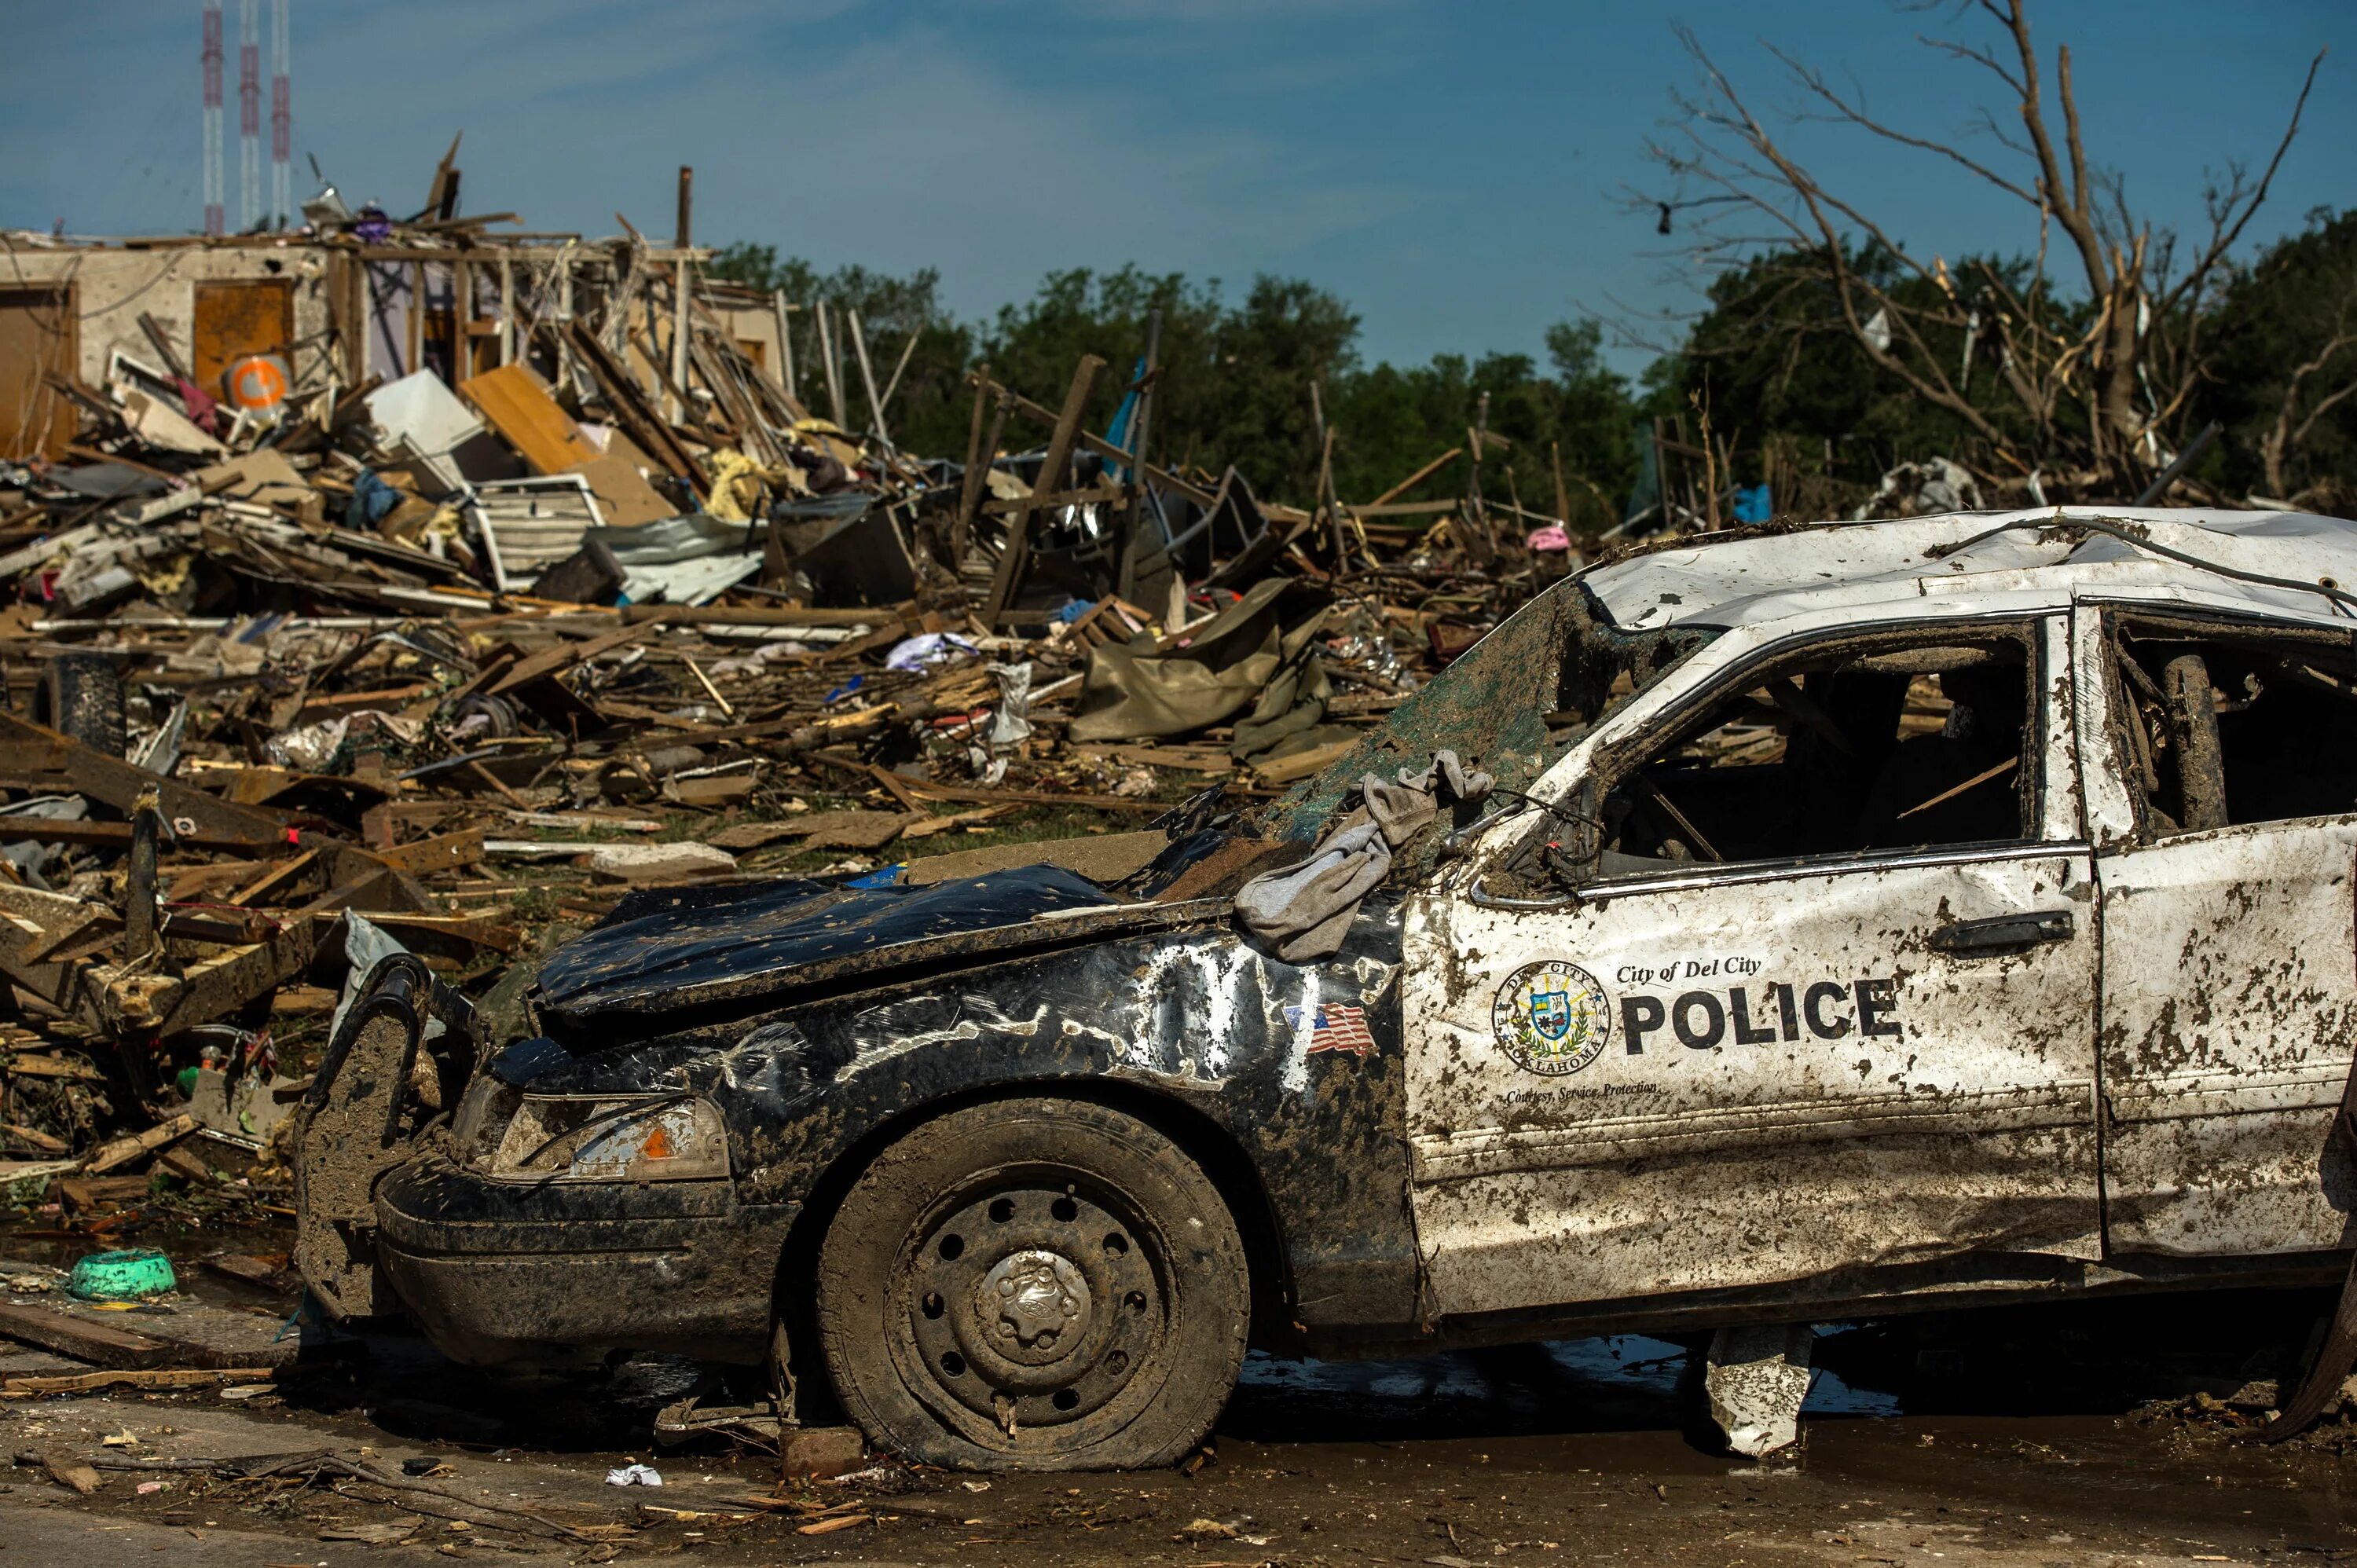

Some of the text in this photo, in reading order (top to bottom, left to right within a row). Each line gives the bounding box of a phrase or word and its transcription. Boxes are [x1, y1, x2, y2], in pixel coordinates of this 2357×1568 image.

[1550, 962, 1590, 984] CITY
[1616, 955, 1762, 985] City of Del City
[1619, 978, 1903, 1056] POLICE
